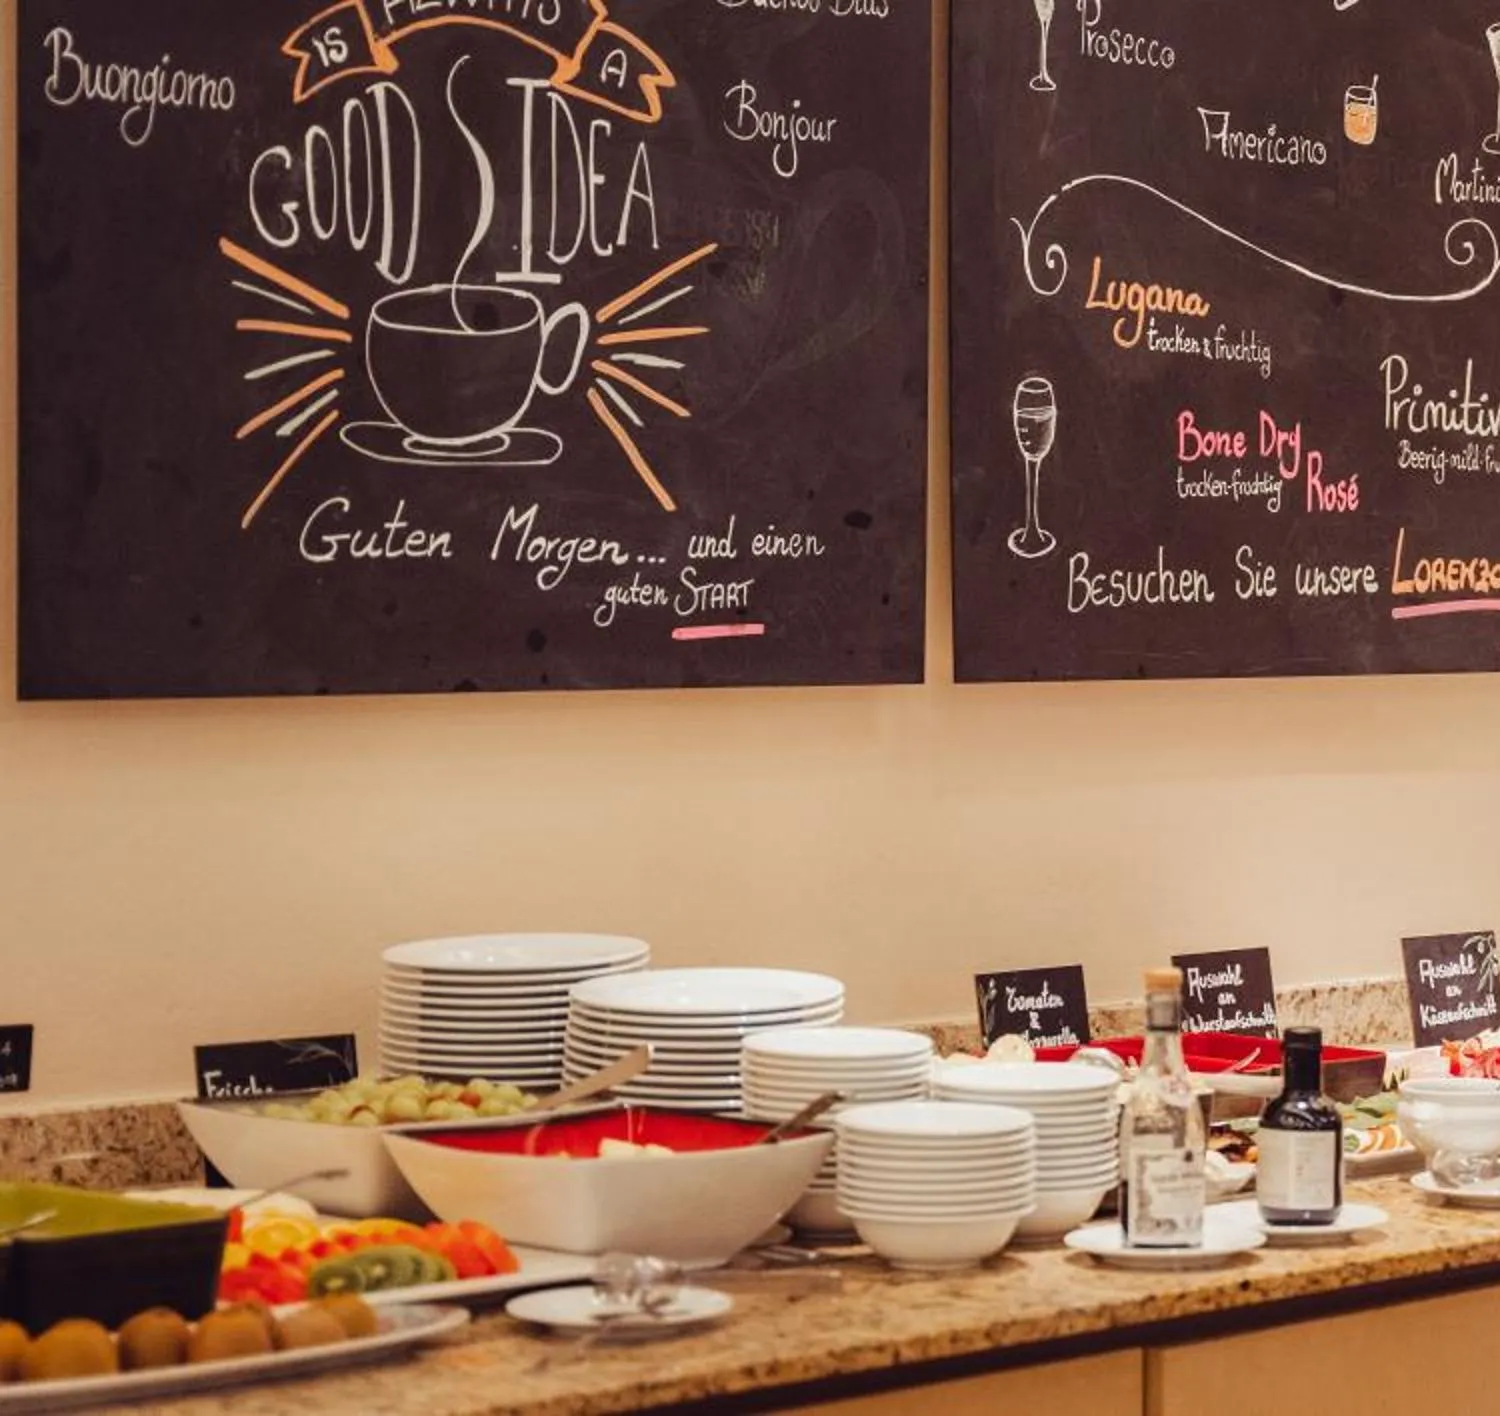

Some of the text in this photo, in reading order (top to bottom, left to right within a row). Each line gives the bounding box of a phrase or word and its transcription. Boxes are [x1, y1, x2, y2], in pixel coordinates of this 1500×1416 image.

[312, 27, 349, 68] IS
[600, 48, 628, 88] A
[1075, 0, 1176, 69] Prosecco
[44, 27, 235, 146] Buongiorno
[725, 79, 838, 178] Bonjour
[1196, 106, 1327, 166] Americano
[249, 81, 421, 284] GOOD
[494, 77, 660, 285] IDEA
[1084, 255, 1211, 350] Lugana
[1214, 323, 1272, 380] fruchtig
[1177, 409, 1301, 480] Bone Dry
[1306, 450, 1360, 513] Rosé
[299, 496, 453, 562] Guten
[687, 514, 737, 560] und
[751, 524, 826, 558] einen
[593, 565, 755, 628] guten START
[1067, 545, 1215, 613] Besuchen
[1235, 544, 1278, 600] Sie
[1295, 562, 1380, 598] unsere
